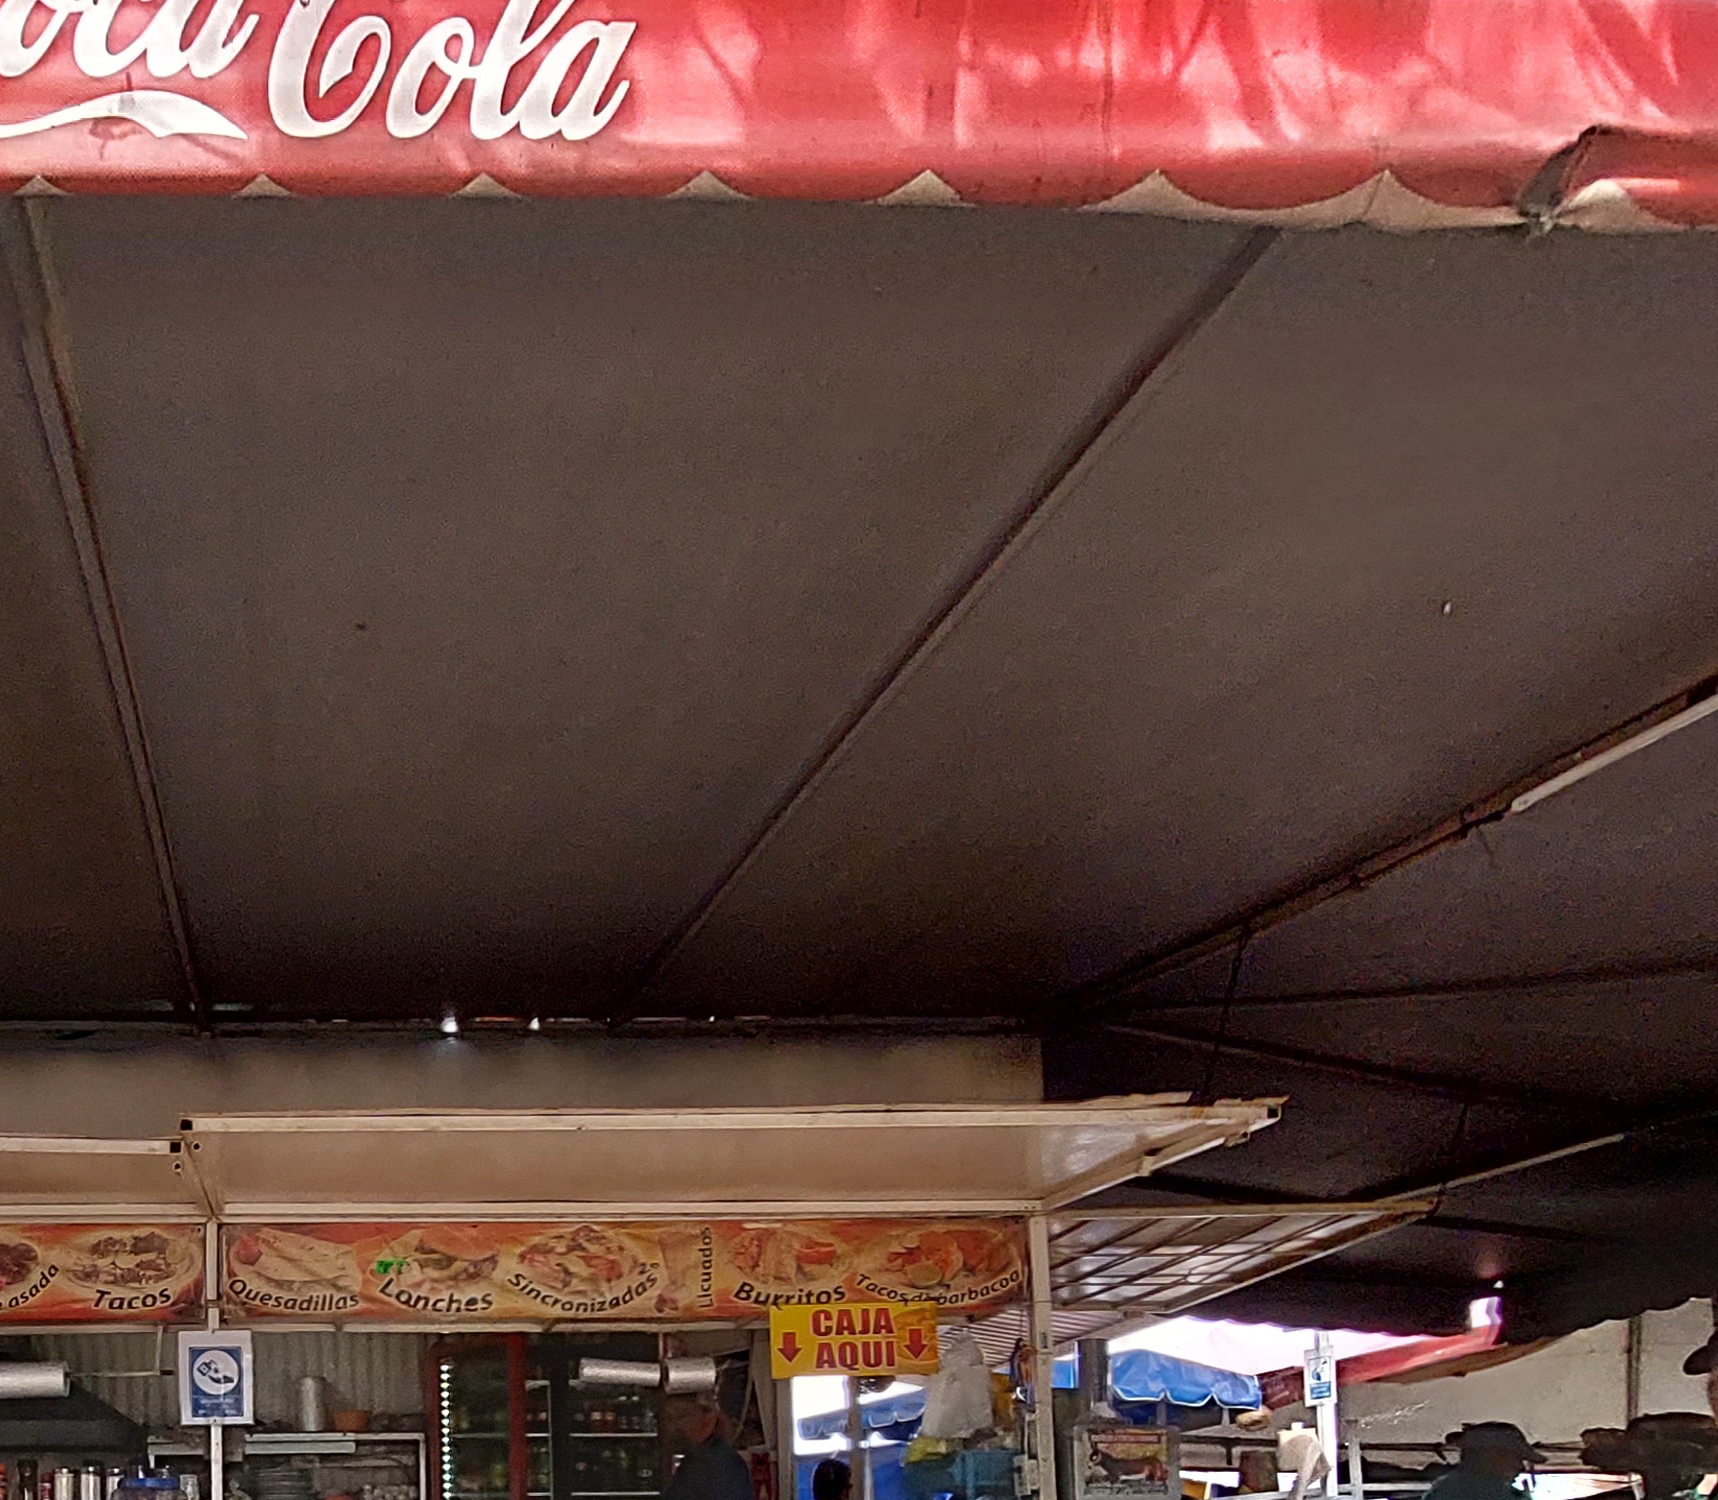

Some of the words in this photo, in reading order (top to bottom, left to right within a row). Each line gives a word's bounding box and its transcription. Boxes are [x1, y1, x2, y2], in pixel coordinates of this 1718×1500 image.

[268, 0, 637, 140] Cola
[697, 1227, 714, 1308] Licuados
[8, 1263, 60, 1309] asada
[93, 1288, 172, 1310] Tacos
[228, 1278, 360, 1312] Quesadillas
[507, 1272, 659, 1313] Sincronizadas
[733, 1281, 846, 1311] Burritos
[855, 1273, 909, 1304] Tacos
[810, 1308, 895, 1337] CAJA
[815, 1340, 896, 1371] AQUI
